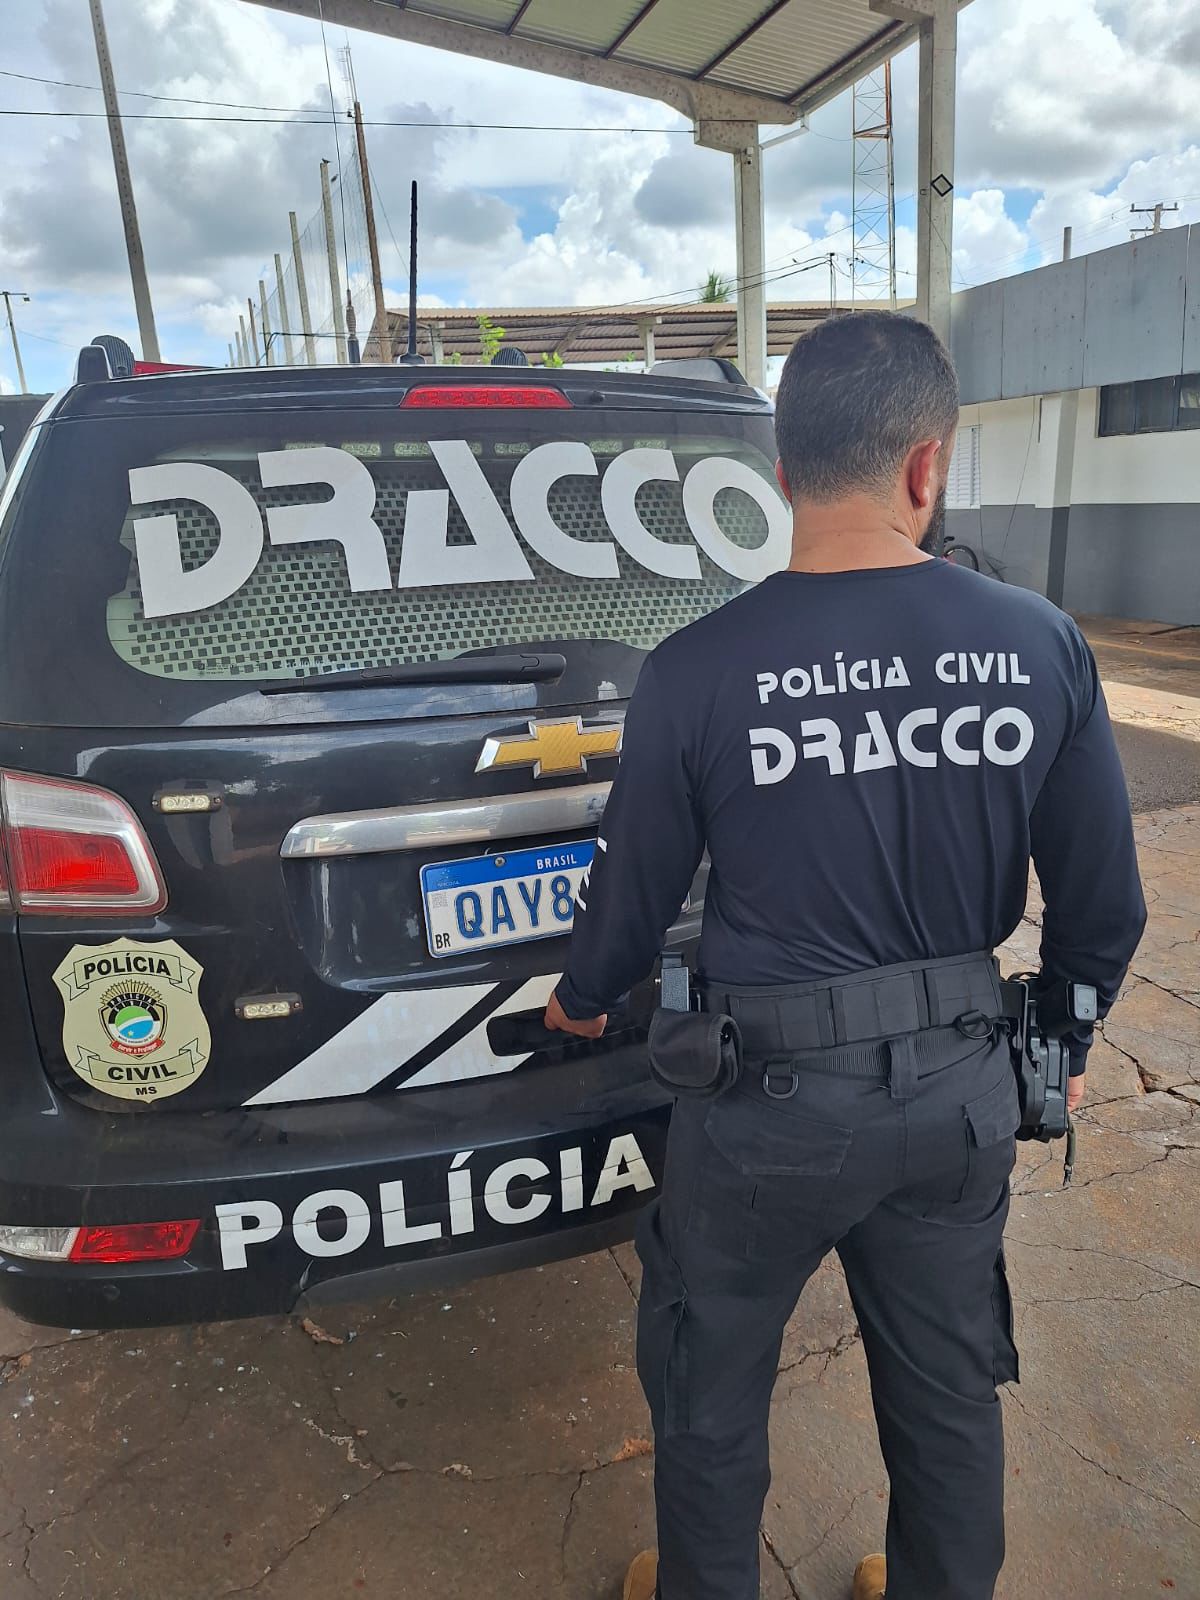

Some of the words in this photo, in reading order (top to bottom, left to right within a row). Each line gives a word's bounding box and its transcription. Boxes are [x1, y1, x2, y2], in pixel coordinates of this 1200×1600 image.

[128, 440, 794, 619] DRACCO
[756, 651, 911, 704] POLÍCIA
[935, 652, 1031, 685] CIVIL
[748, 705, 1035, 786] DRACCO
[536, 853, 578, 870] BRASIL
[435, 932, 451, 950] BR
[83, 953, 171, 980] POLÍCIA
[107, 1063, 177, 1081] CIVIL
[135, 1086, 157, 1096] MS
[214, 1132, 656, 1271] POLÍCIA
